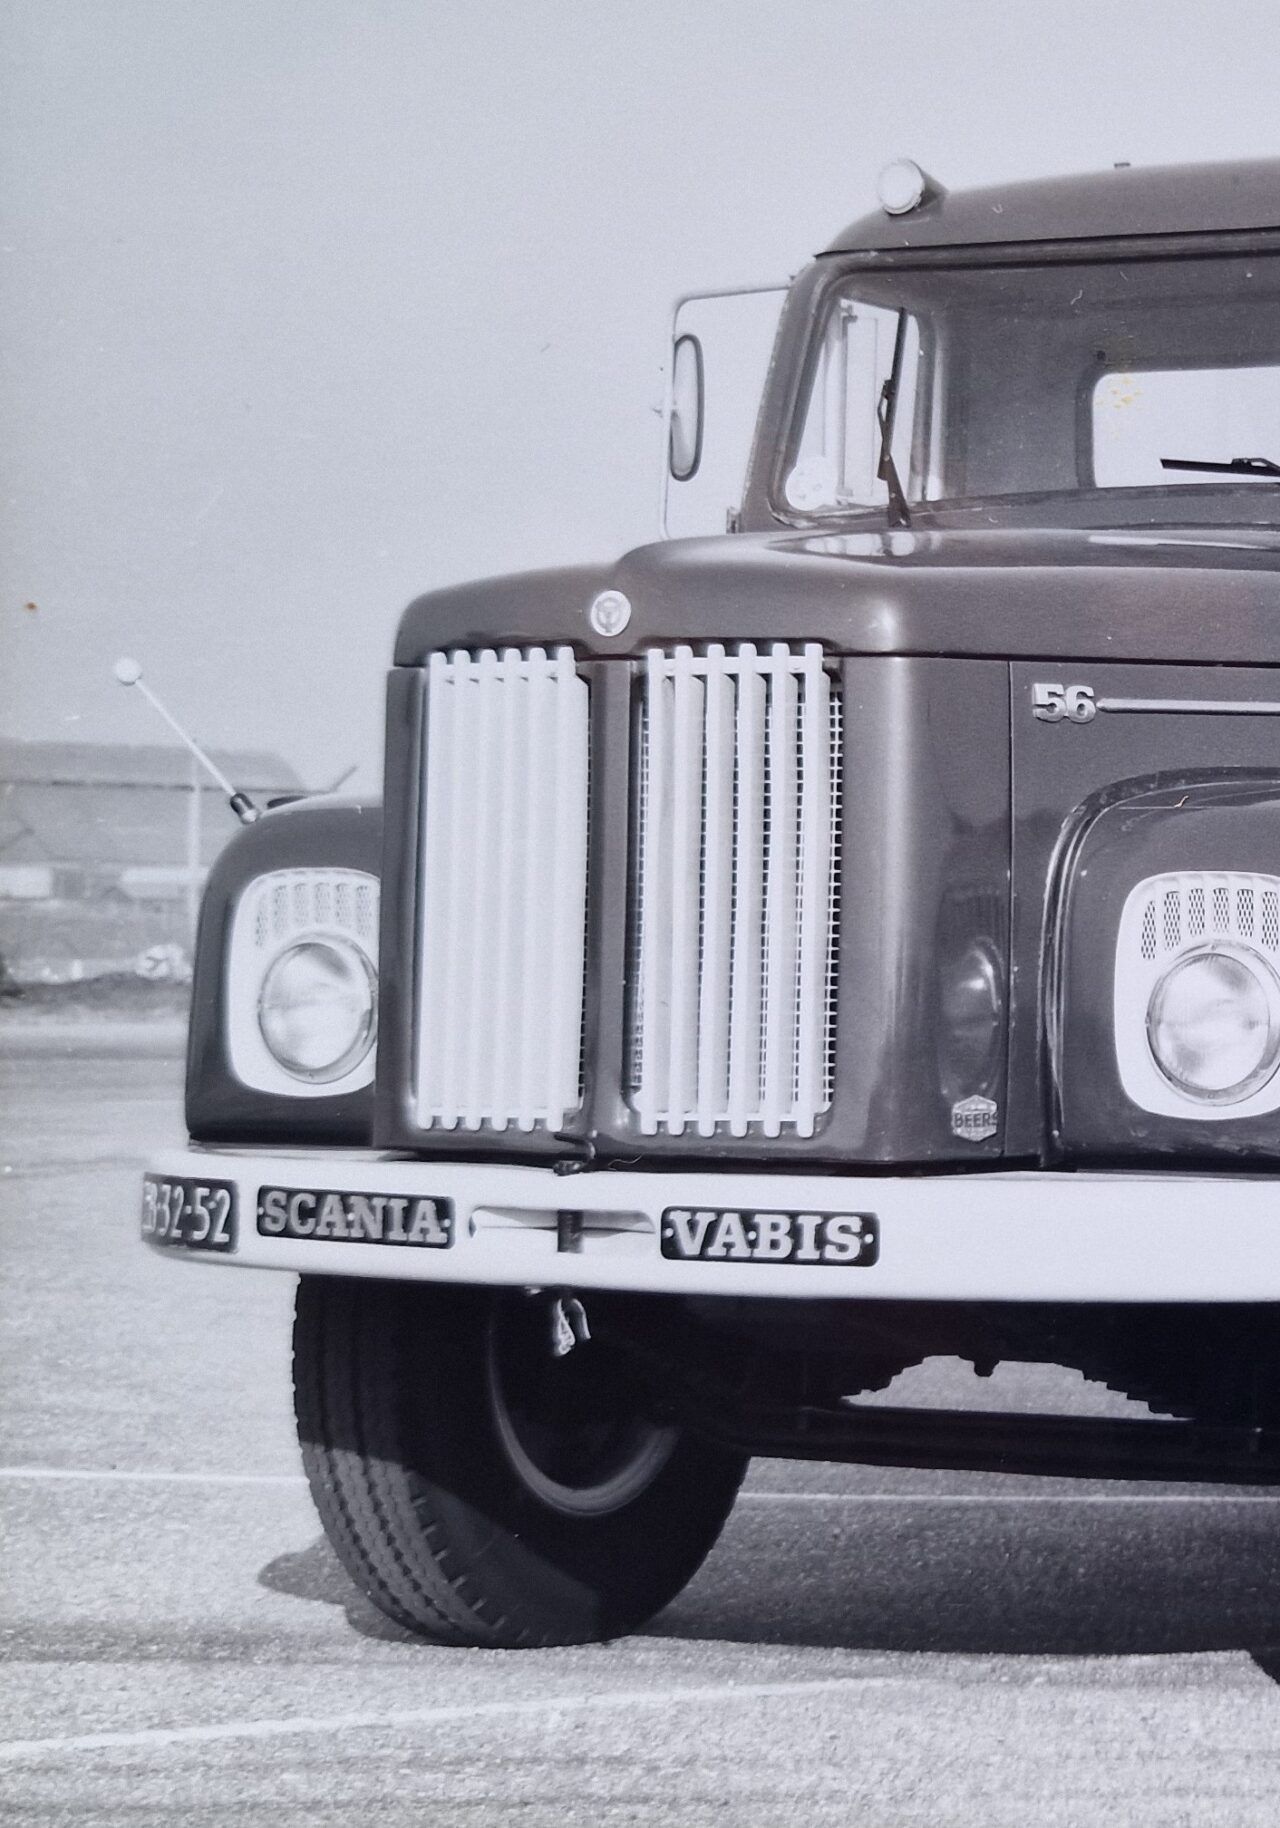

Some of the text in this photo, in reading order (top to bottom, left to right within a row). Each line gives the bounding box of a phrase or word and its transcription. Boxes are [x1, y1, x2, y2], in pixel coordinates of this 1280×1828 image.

[1032, 683, 1096, 723] 56
[953, 1111, 999, 1128] BEERS
[262, 1190, 863, 1261] SCANIA VABIS
